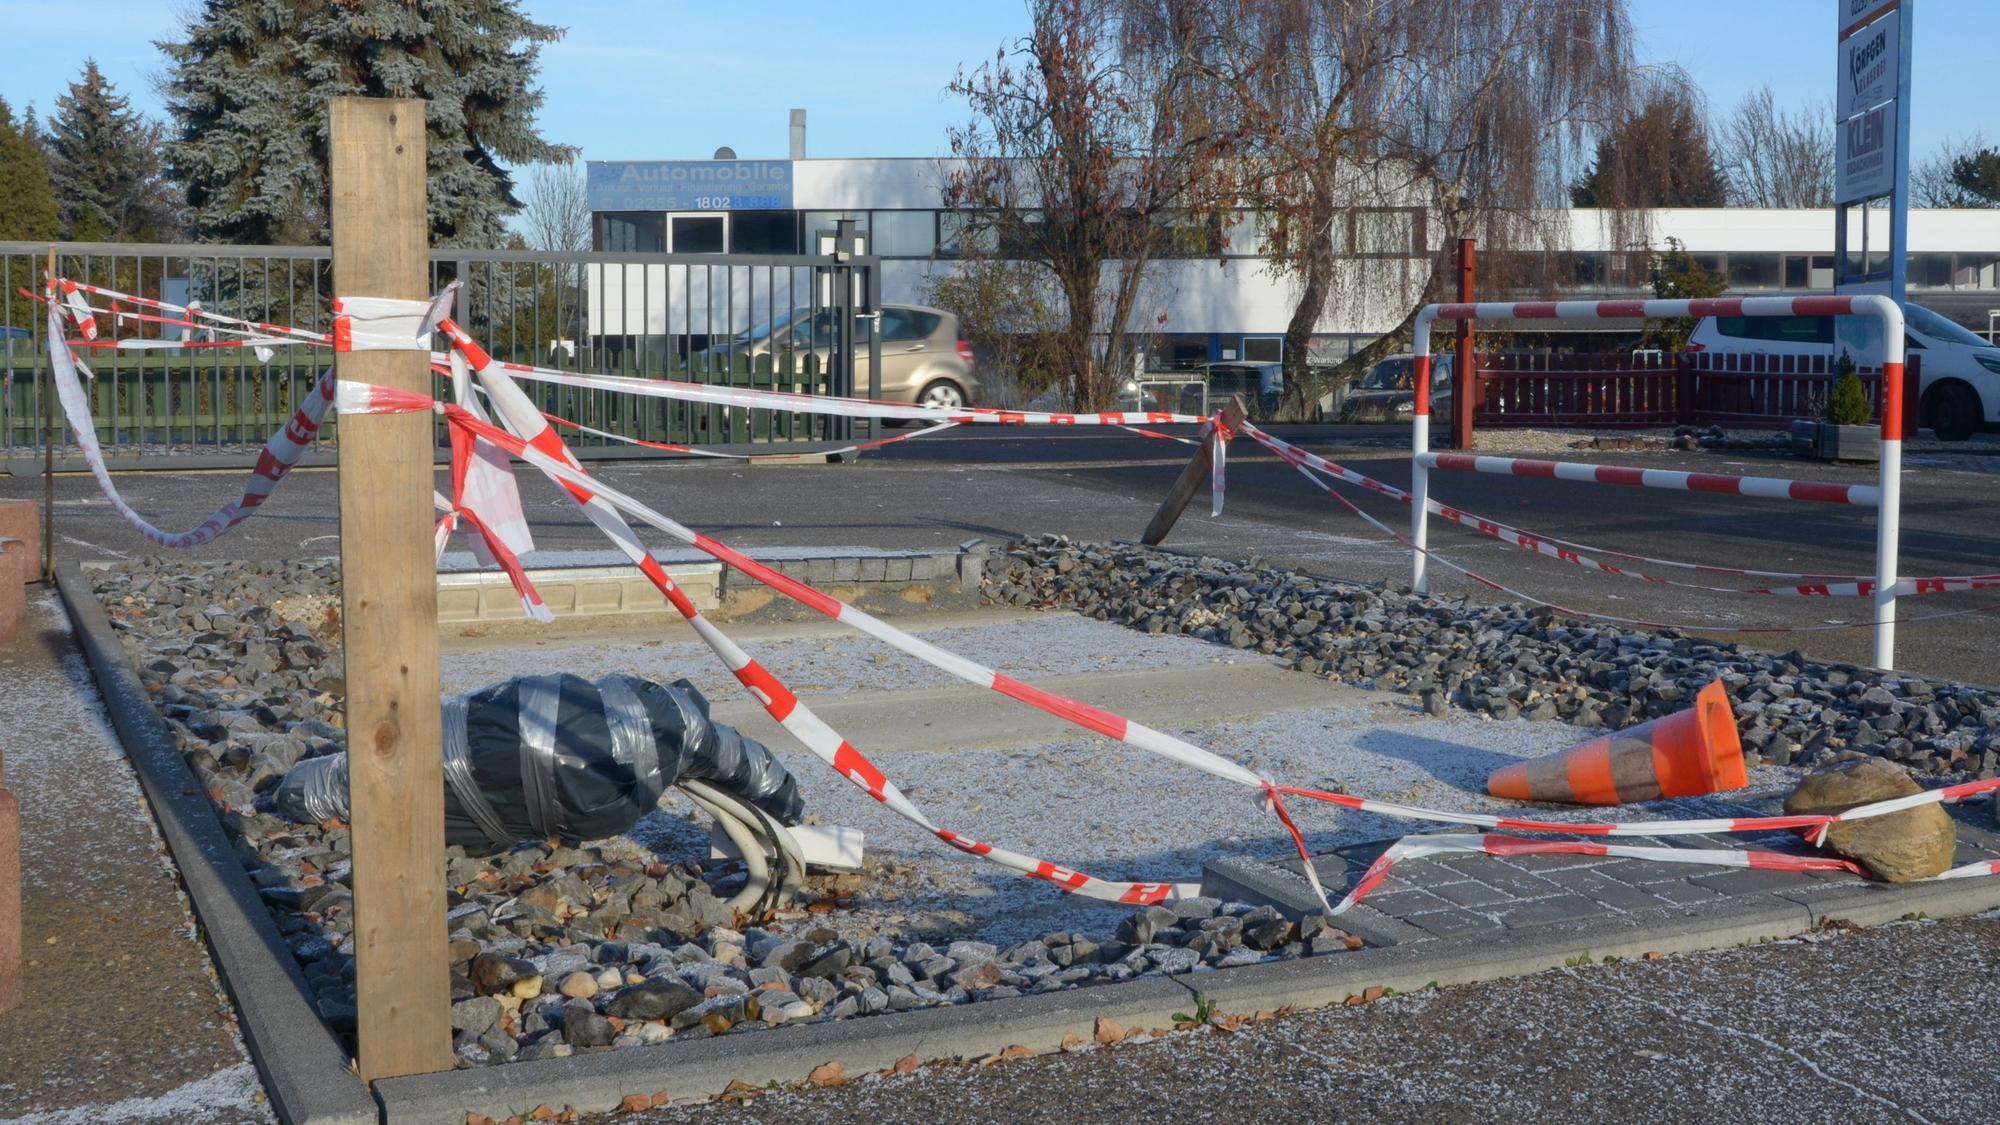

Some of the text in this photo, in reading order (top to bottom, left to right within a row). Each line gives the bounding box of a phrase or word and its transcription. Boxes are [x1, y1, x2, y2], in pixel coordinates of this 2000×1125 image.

[1850, 29, 1886, 95] KÖRFGEN
[1847, 108, 1885, 160] KLEIN
[621, 163, 785, 182] Automobile
[623, 196, 677, 209] 02255
